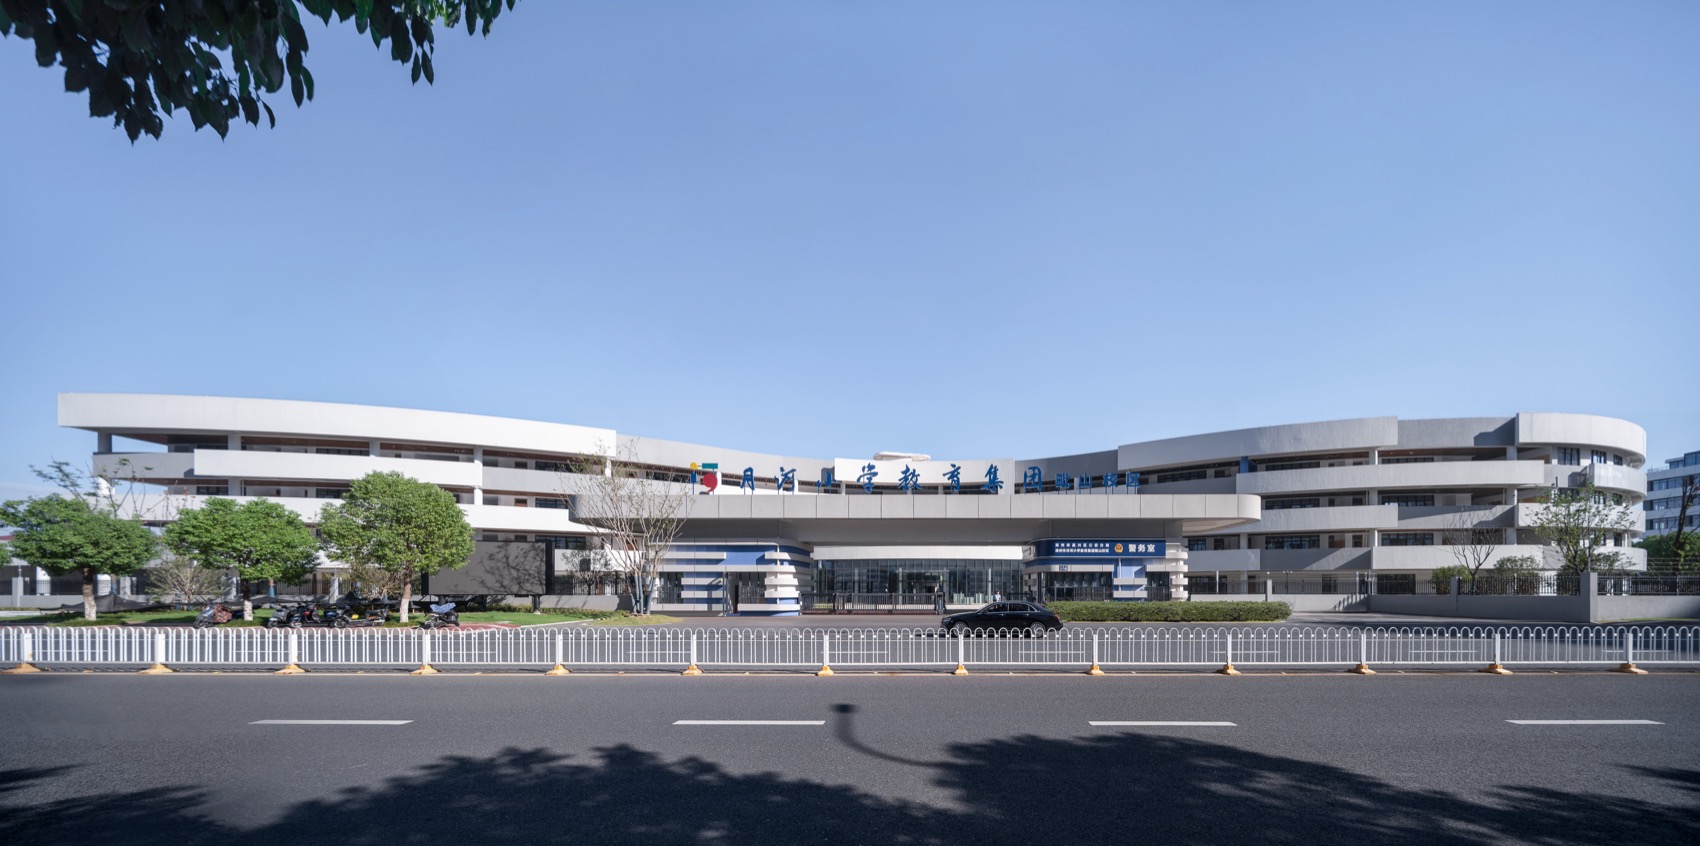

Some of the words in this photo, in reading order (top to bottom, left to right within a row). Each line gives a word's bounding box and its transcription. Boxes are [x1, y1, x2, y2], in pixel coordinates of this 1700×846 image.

[740, 463, 1042, 492] 月河小学教育集团
[1128, 543, 1155, 553] 警务室
